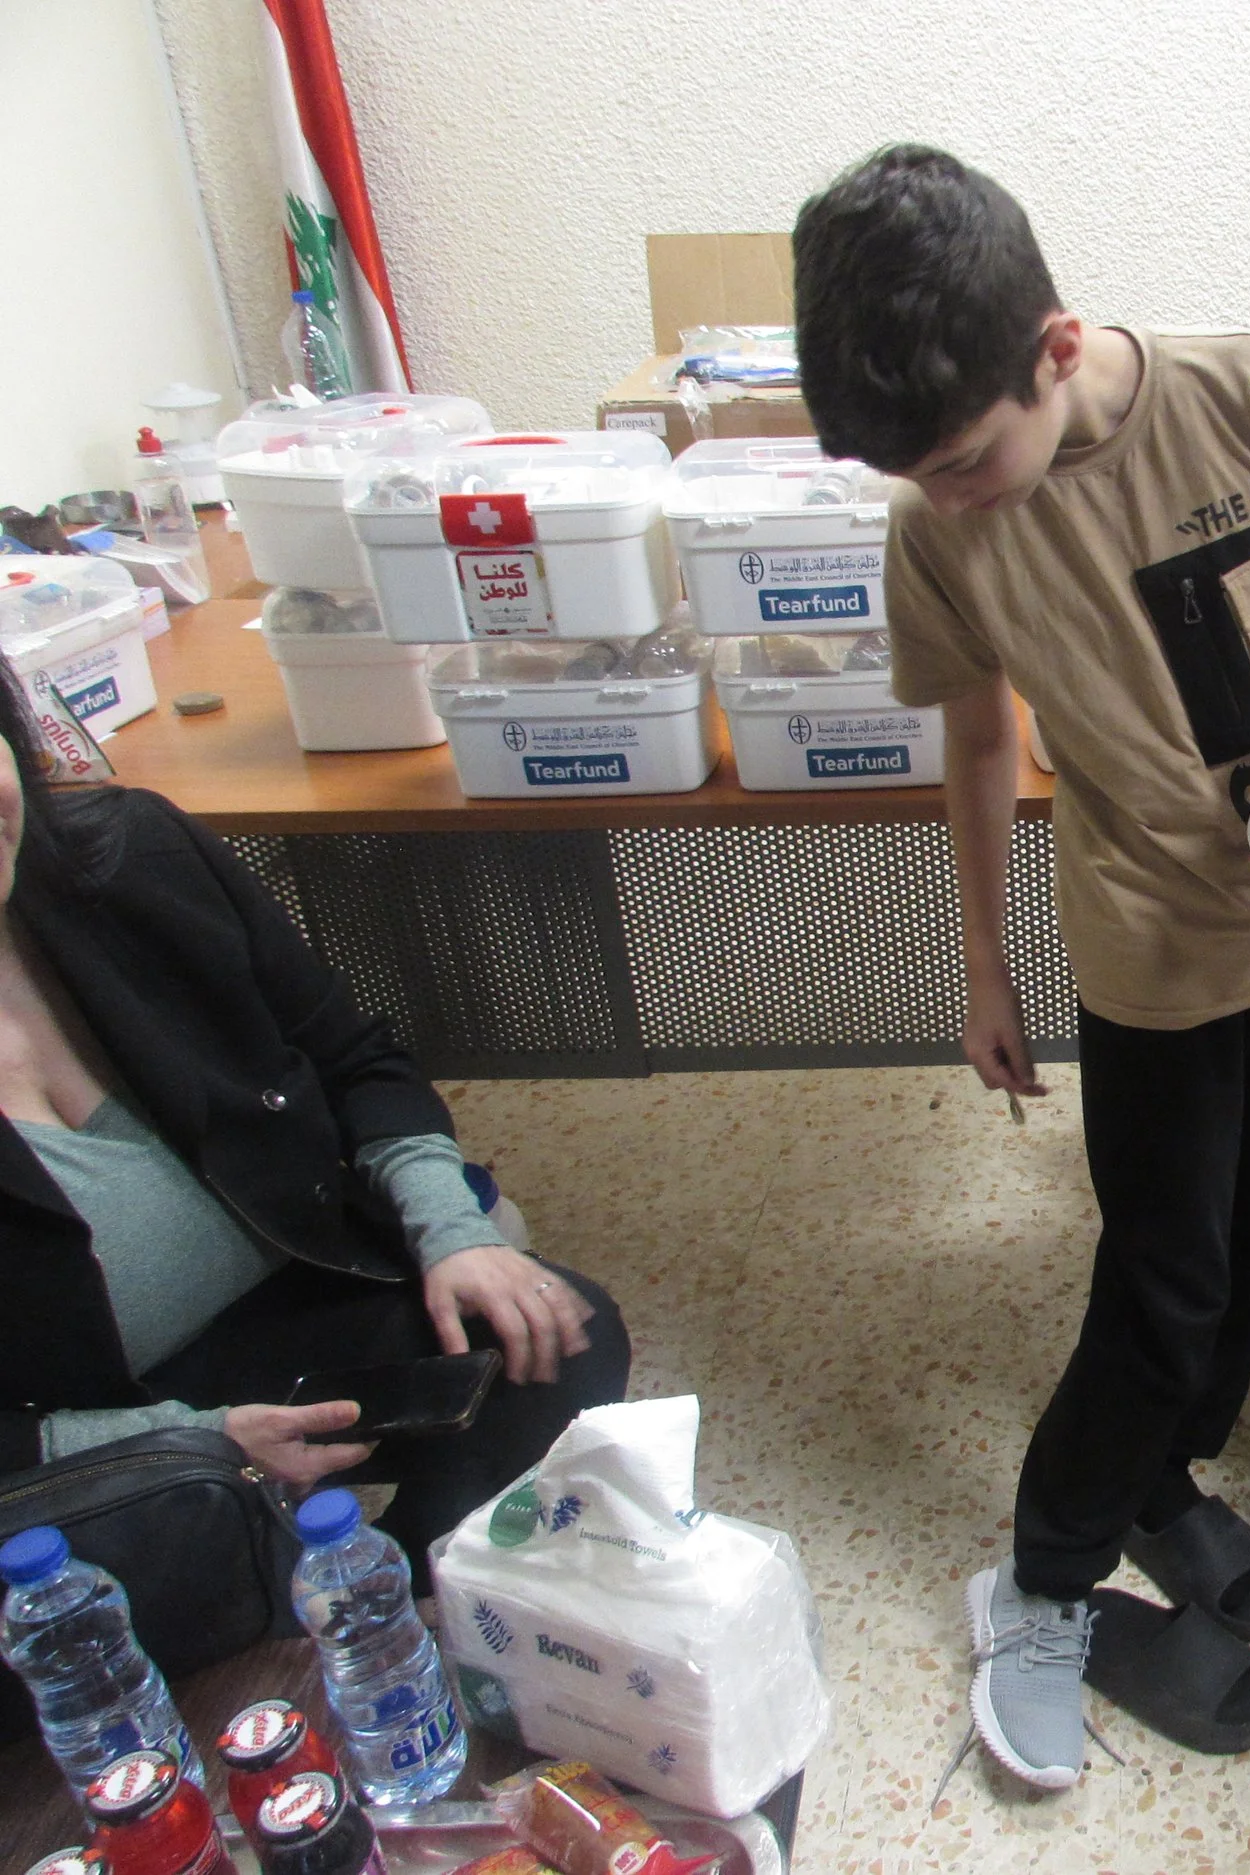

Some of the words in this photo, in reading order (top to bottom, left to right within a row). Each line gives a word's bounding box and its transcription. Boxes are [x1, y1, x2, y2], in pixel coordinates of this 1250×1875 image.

[607, 416, 657, 430] Carepack
[473, 563, 525, 579] كلنا
[480, 581, 528, 601] للوطن
[764, 592, 860, 615] Tearfund
[73, 683, 116, 716] arfund
[529, 760, 620, 779] Tearfund
[812, 751, 902, 772] Tearfund
